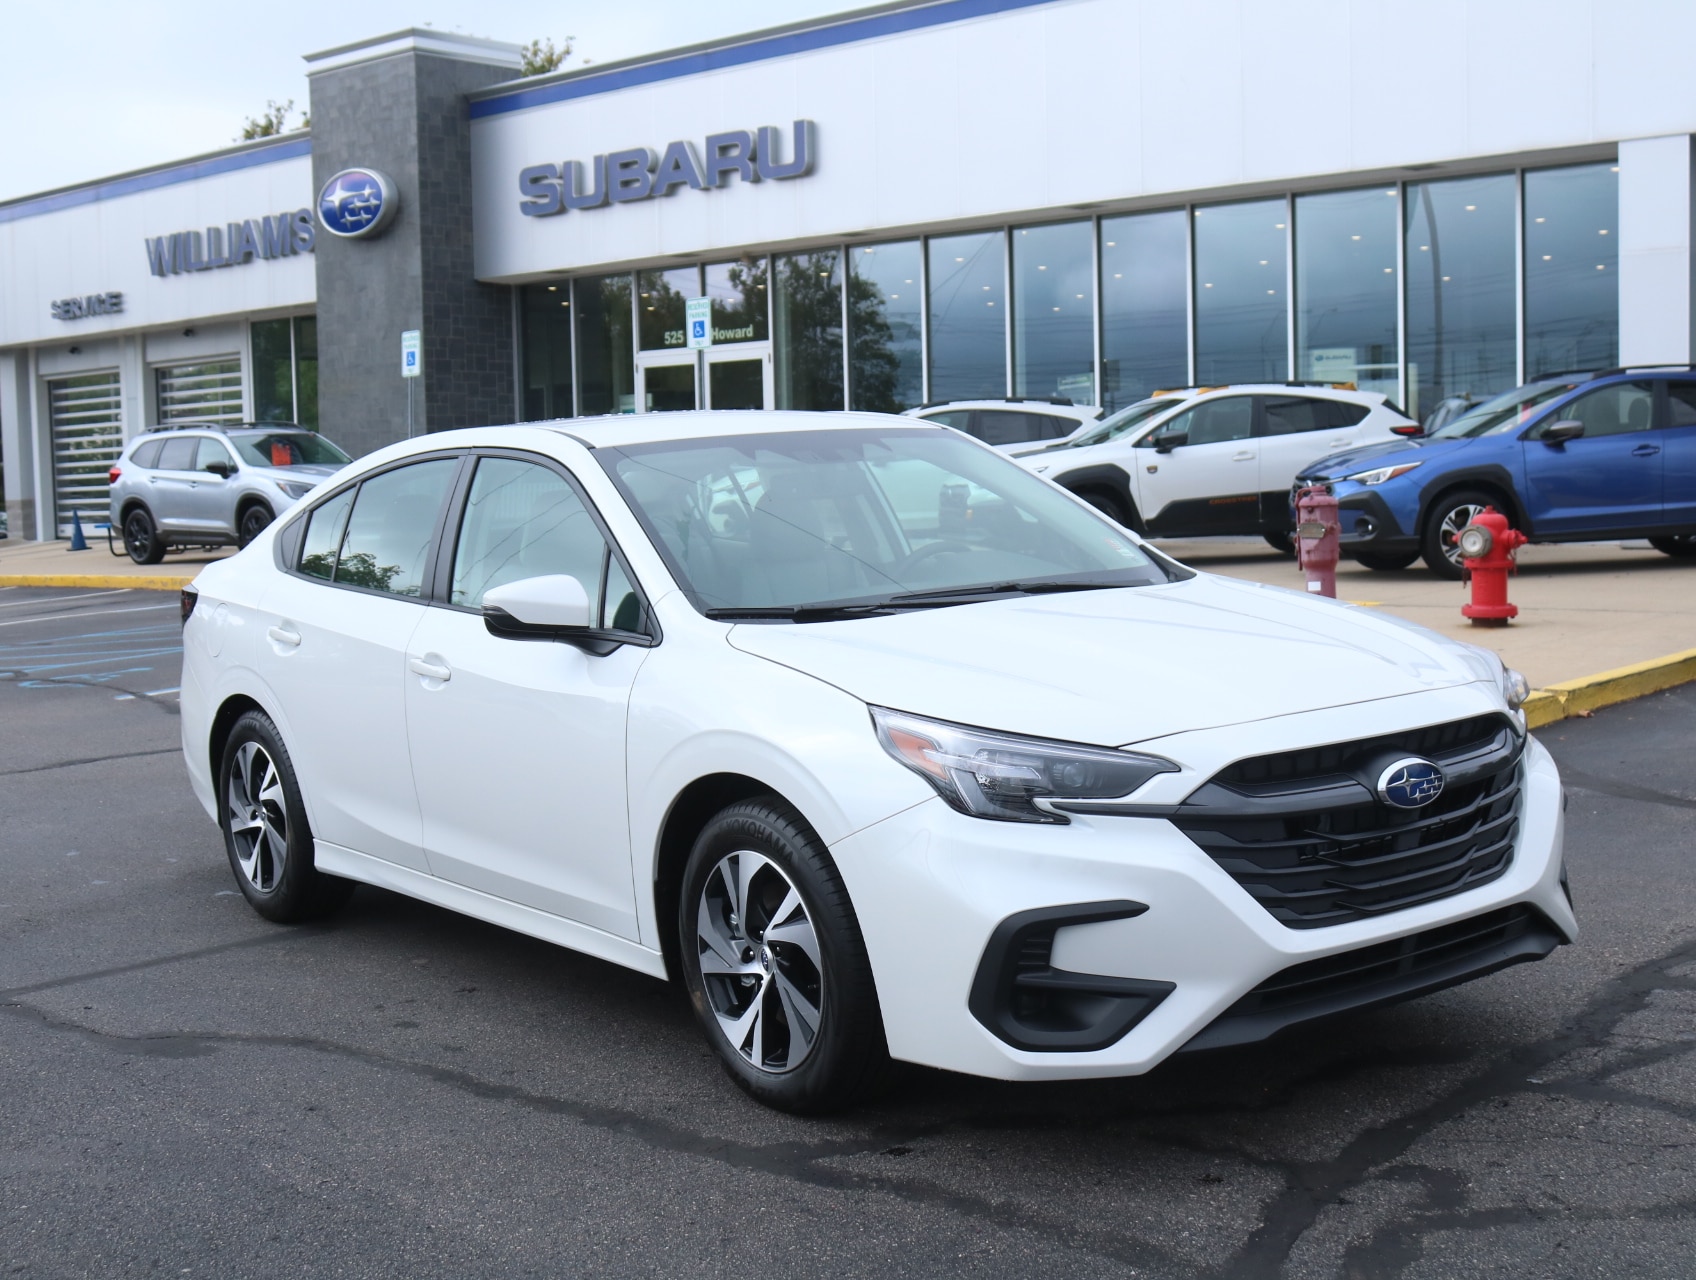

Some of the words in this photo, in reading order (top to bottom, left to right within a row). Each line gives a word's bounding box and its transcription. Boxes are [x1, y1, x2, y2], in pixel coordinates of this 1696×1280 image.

[519, 119, 814, 217] SUBARU
[144, 207, 316, 277] WILLIAMS
[50, 291, 123, 320] SERVICE
[663, 330, 684, 345] 525
[711, 323, 754, 340] Howard
[725, 819, 794, 866] YOKOHAMA
